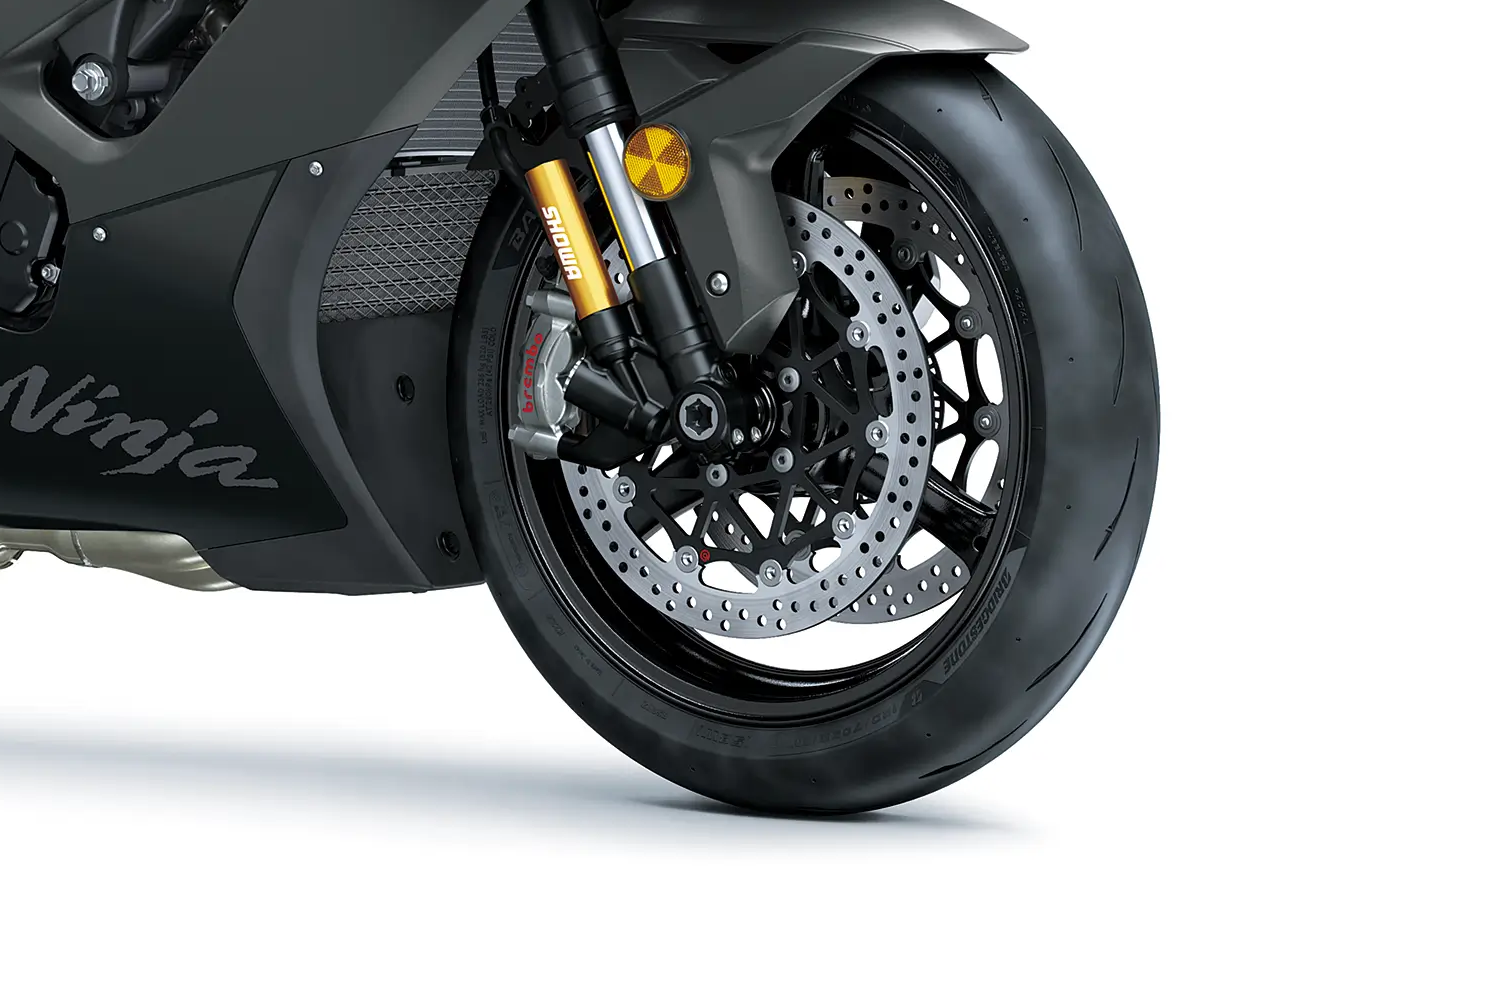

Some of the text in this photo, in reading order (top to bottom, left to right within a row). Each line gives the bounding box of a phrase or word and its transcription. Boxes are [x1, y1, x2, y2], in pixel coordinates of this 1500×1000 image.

[541, 205, 583, 280] SHOWA
[522, 333, 543, 413] brembo
[942, 570, 1014, 677] BRIDGESTONE
